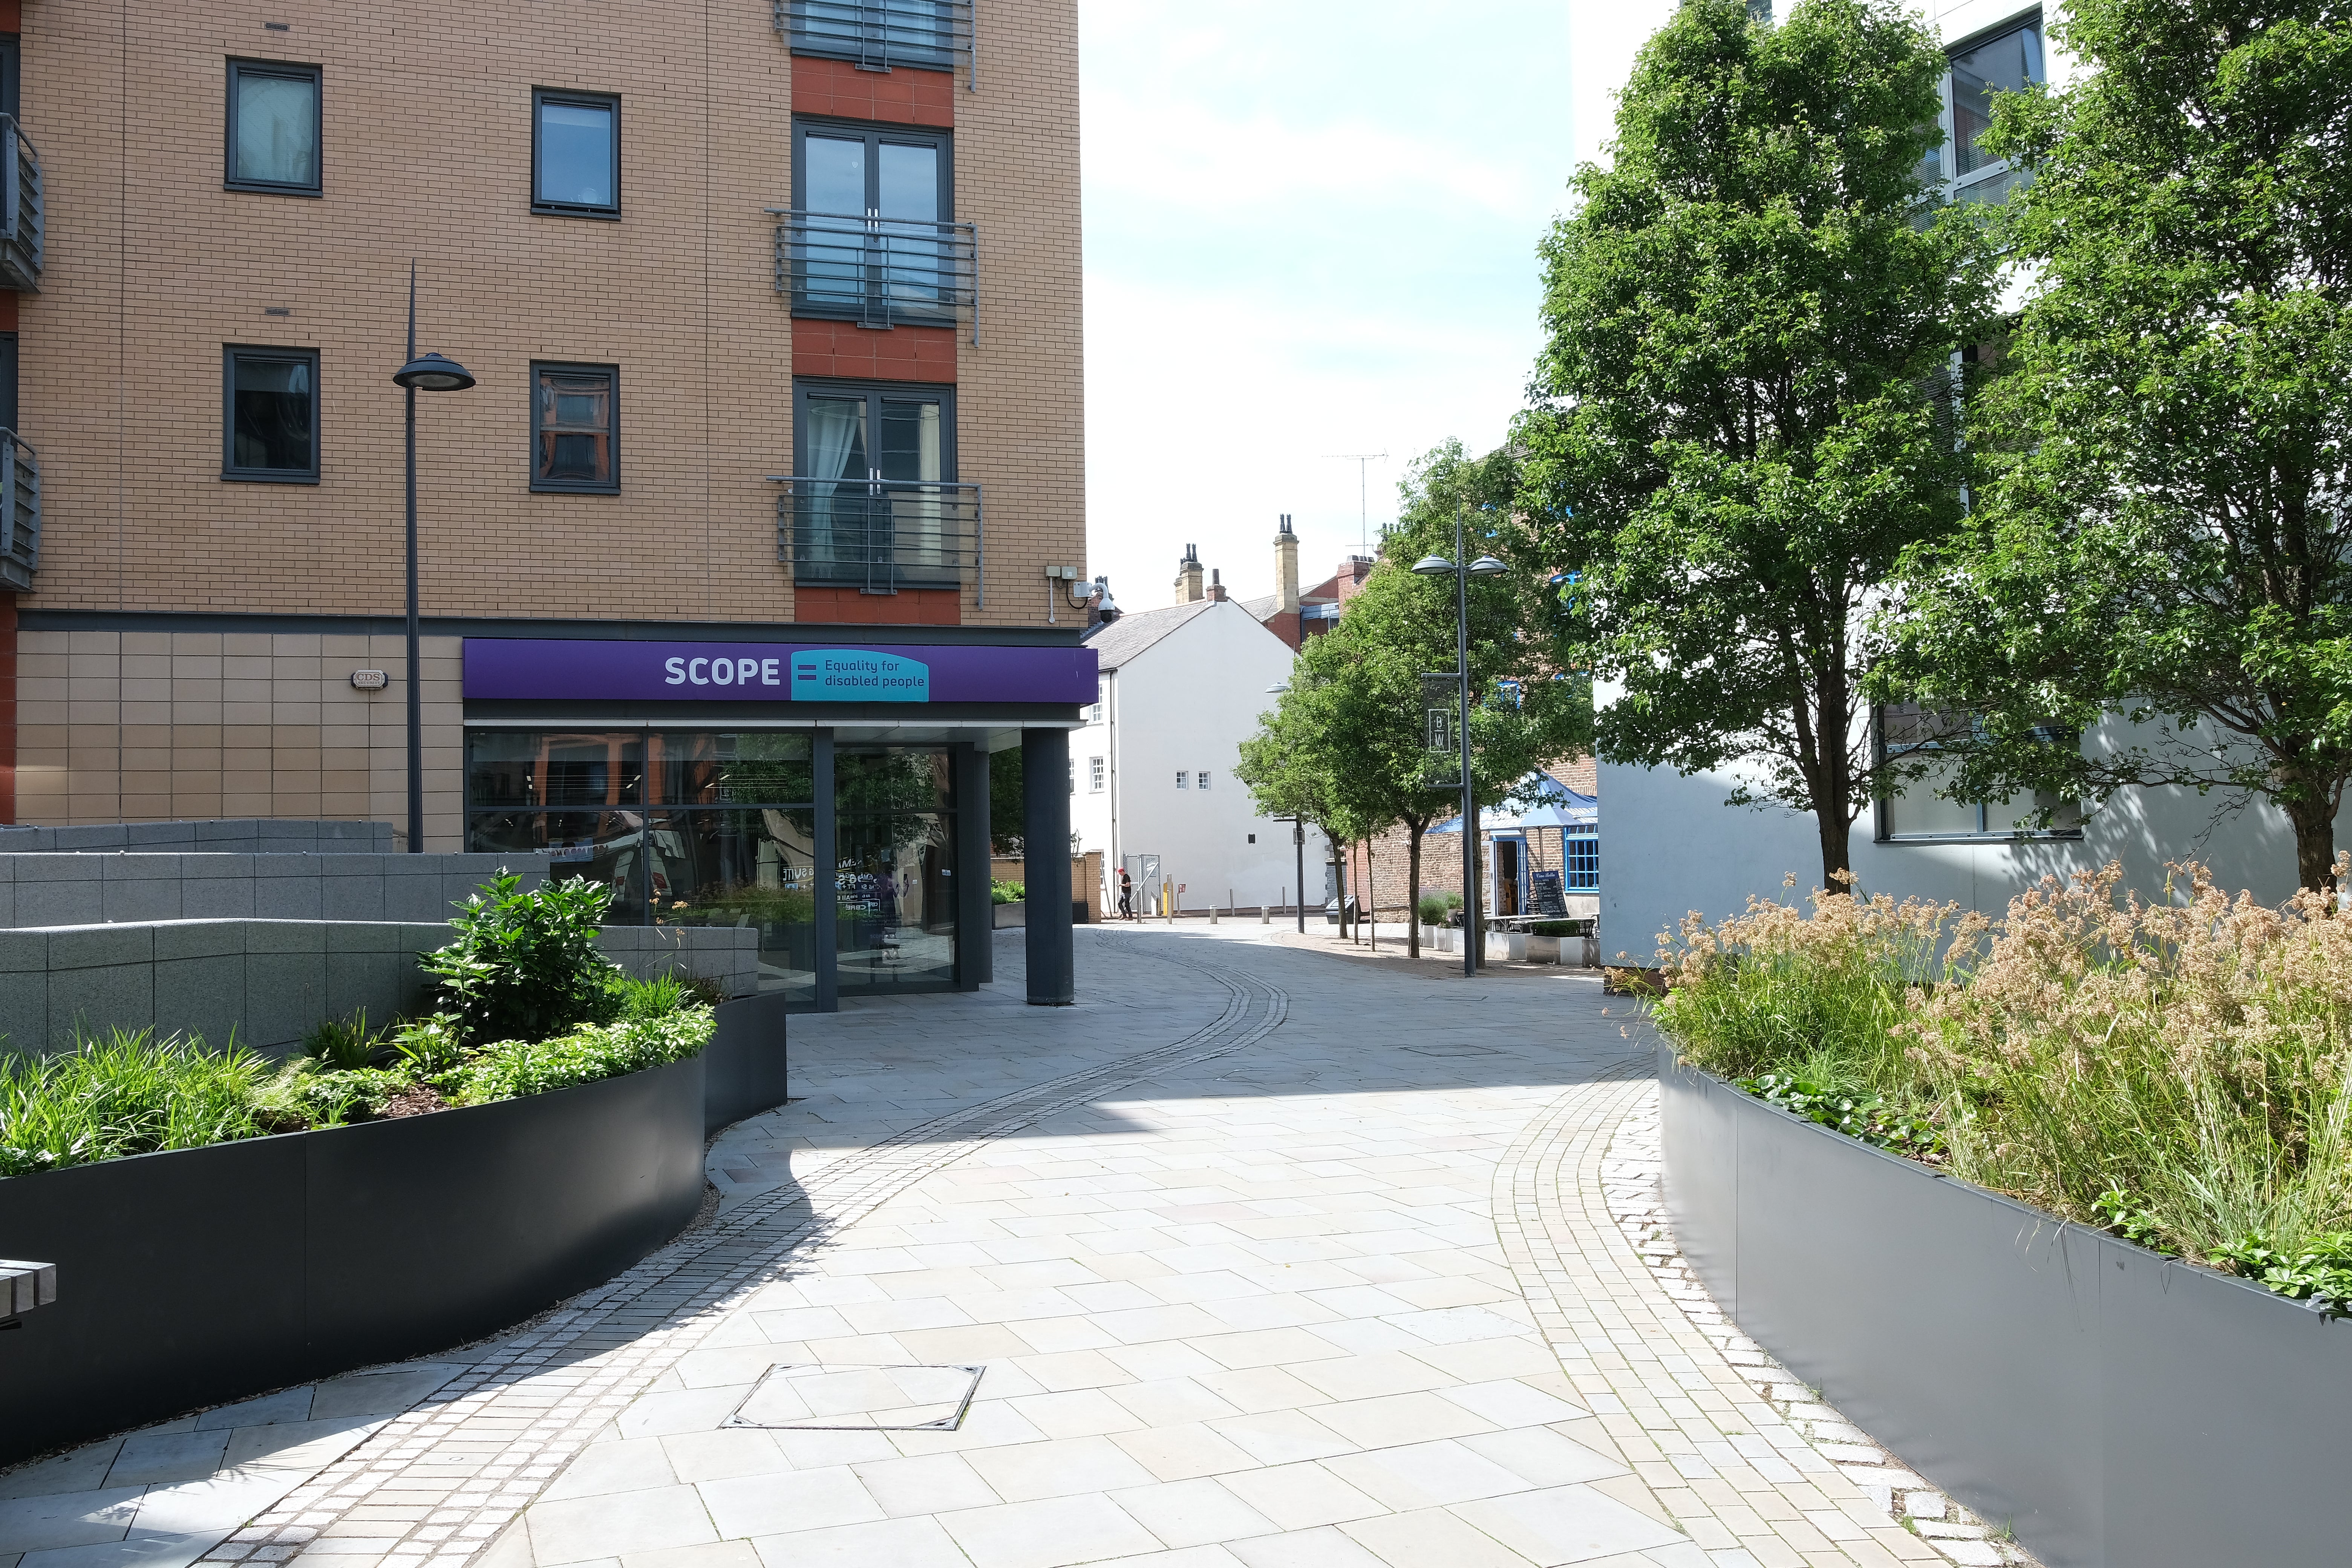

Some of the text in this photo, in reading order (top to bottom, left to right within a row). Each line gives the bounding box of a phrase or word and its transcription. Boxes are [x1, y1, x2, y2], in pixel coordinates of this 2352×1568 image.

[665, 657, 780, 685] SCOPE
[825, 660, 877, 673] Equality
[881, 660, 899, 671] for
[825, 675, 925, 689] disabled people
[1436, 716, 1442, 728] B
